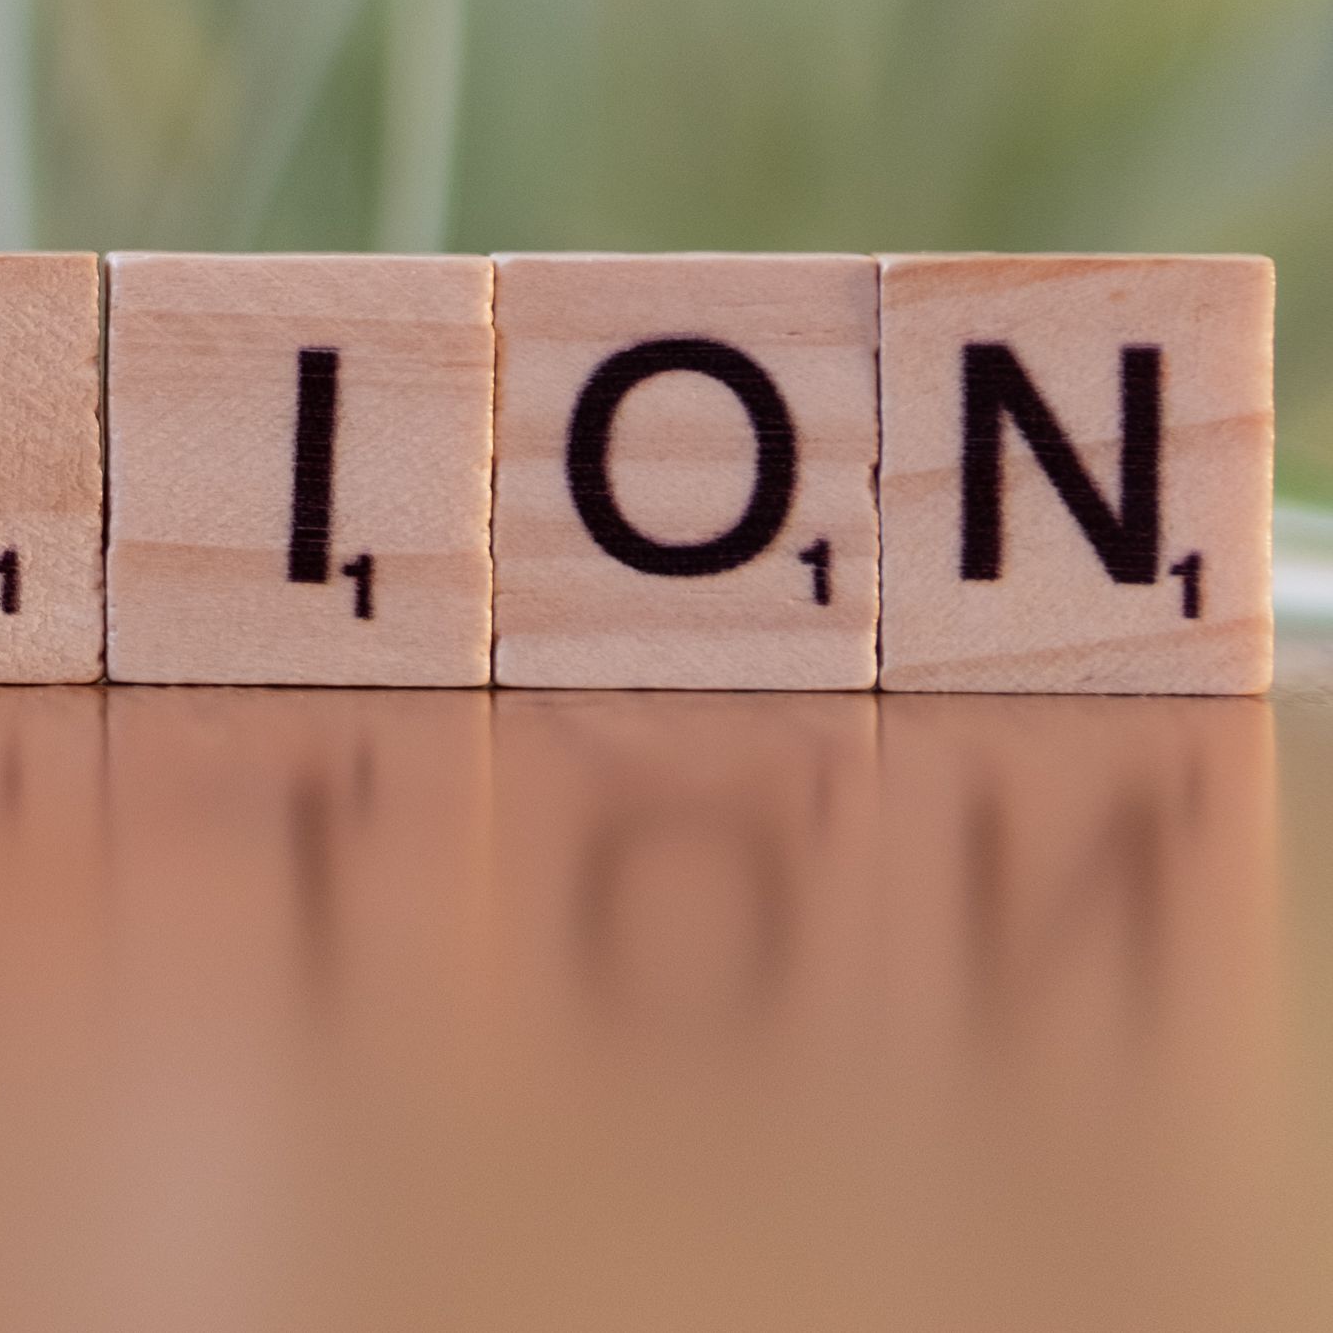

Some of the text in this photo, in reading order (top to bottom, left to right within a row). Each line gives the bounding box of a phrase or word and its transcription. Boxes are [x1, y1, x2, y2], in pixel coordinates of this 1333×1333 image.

[336, 551, 378, 623] 1
[795, 536, 835, 609] 1
[1166, 550, 1205, 622] 1
